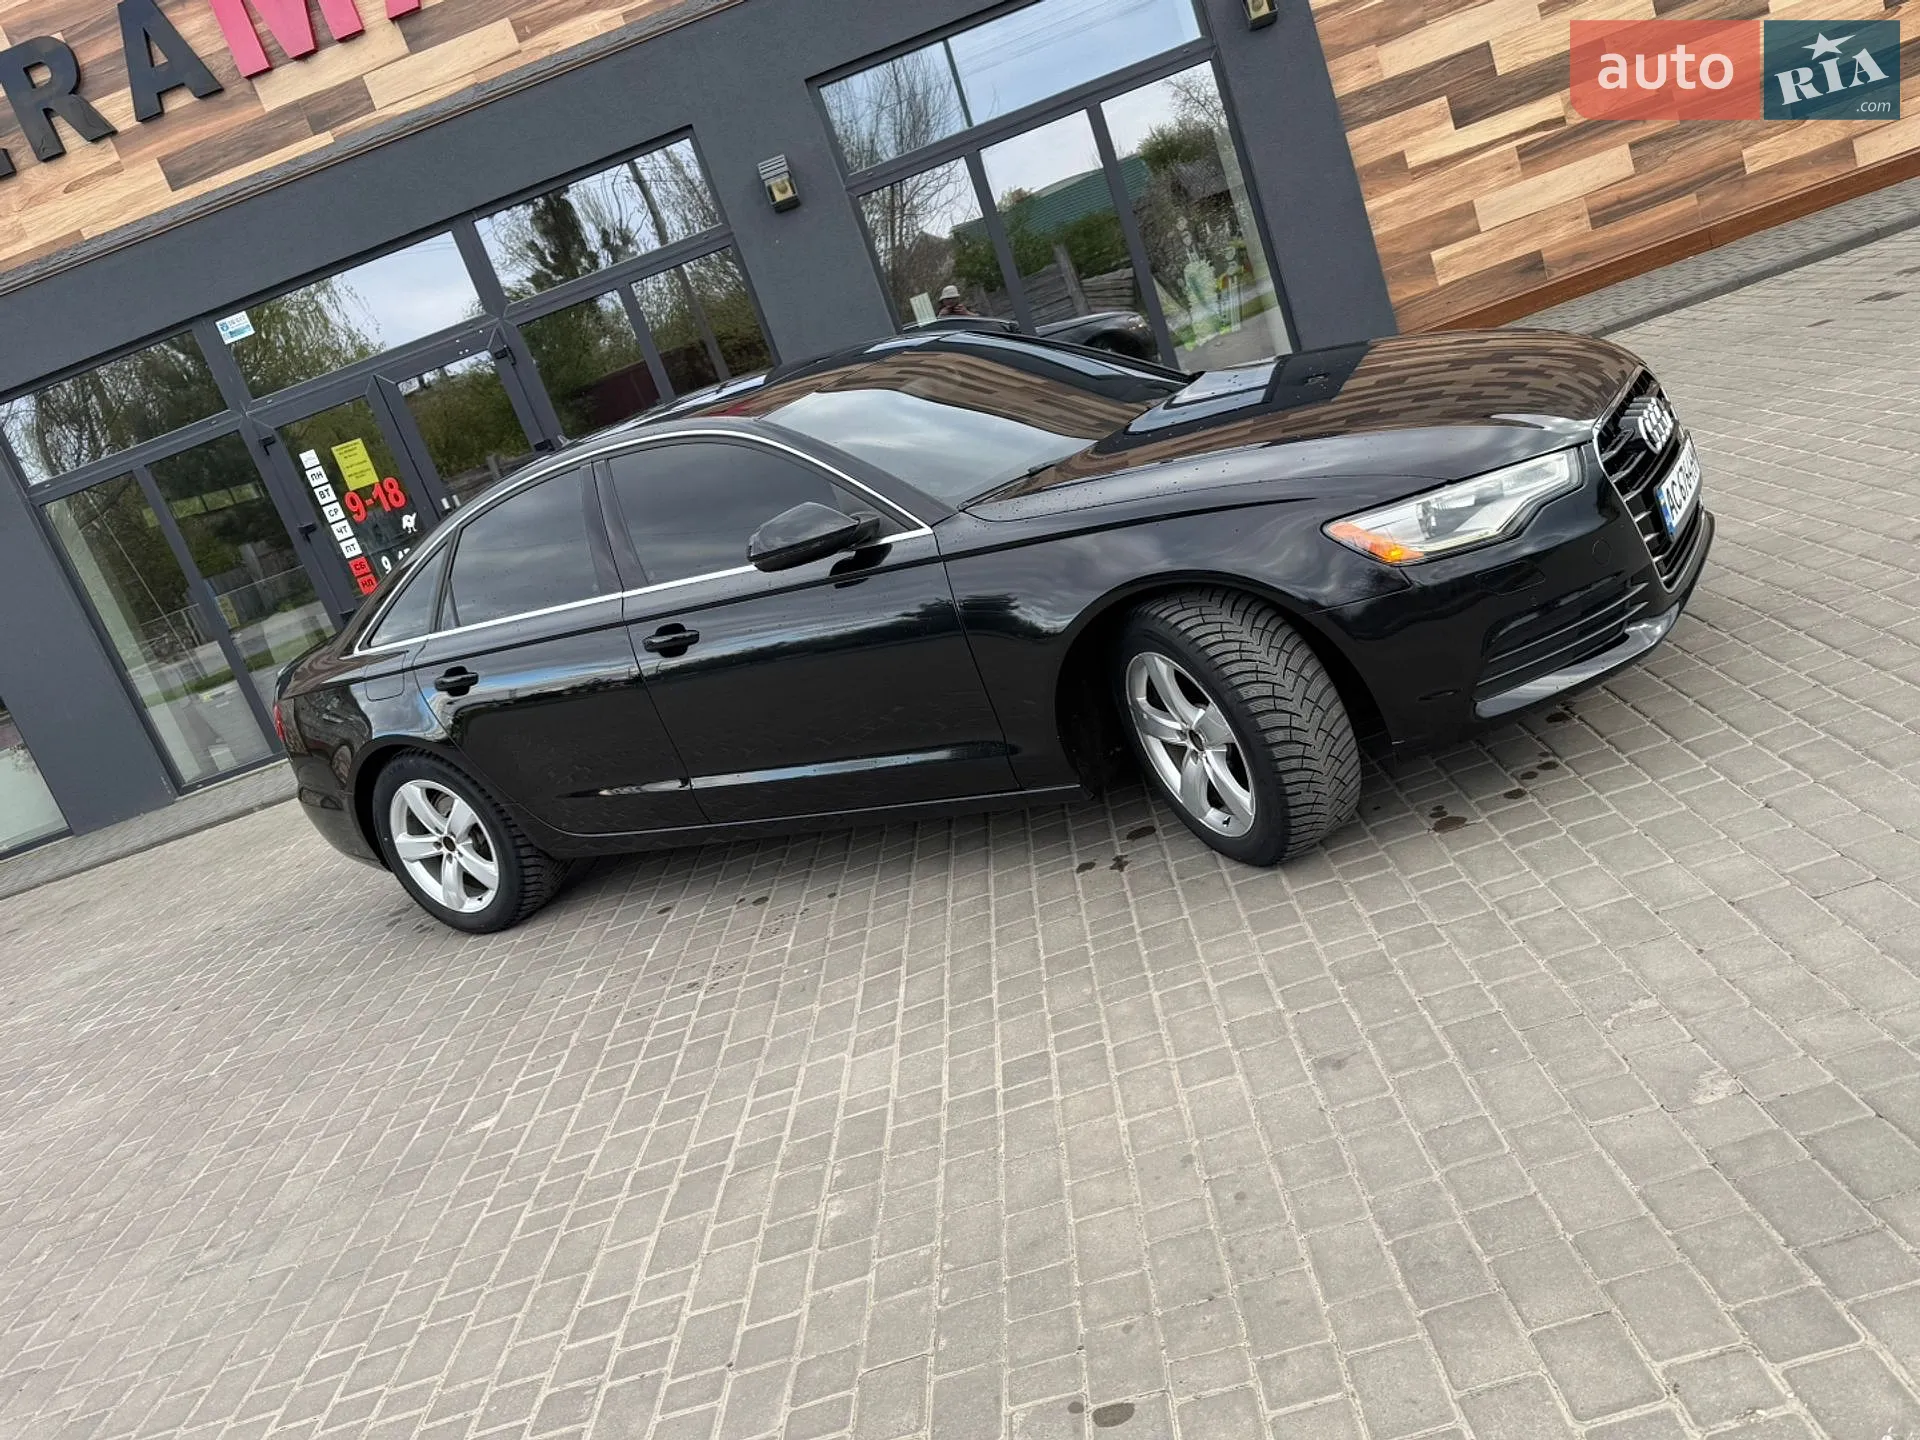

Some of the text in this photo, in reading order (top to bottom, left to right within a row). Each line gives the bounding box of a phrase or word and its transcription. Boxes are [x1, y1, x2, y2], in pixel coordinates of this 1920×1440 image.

[310, 471, 324, 481] ПН
[319, 488, 331, 500] ВТ
[345, 477, 406, 523] 9-18
[328, 508, 339, 517] СР
[336, 525, 348, 534] ЧТ
[345, 543, 356, 553] ПТ
